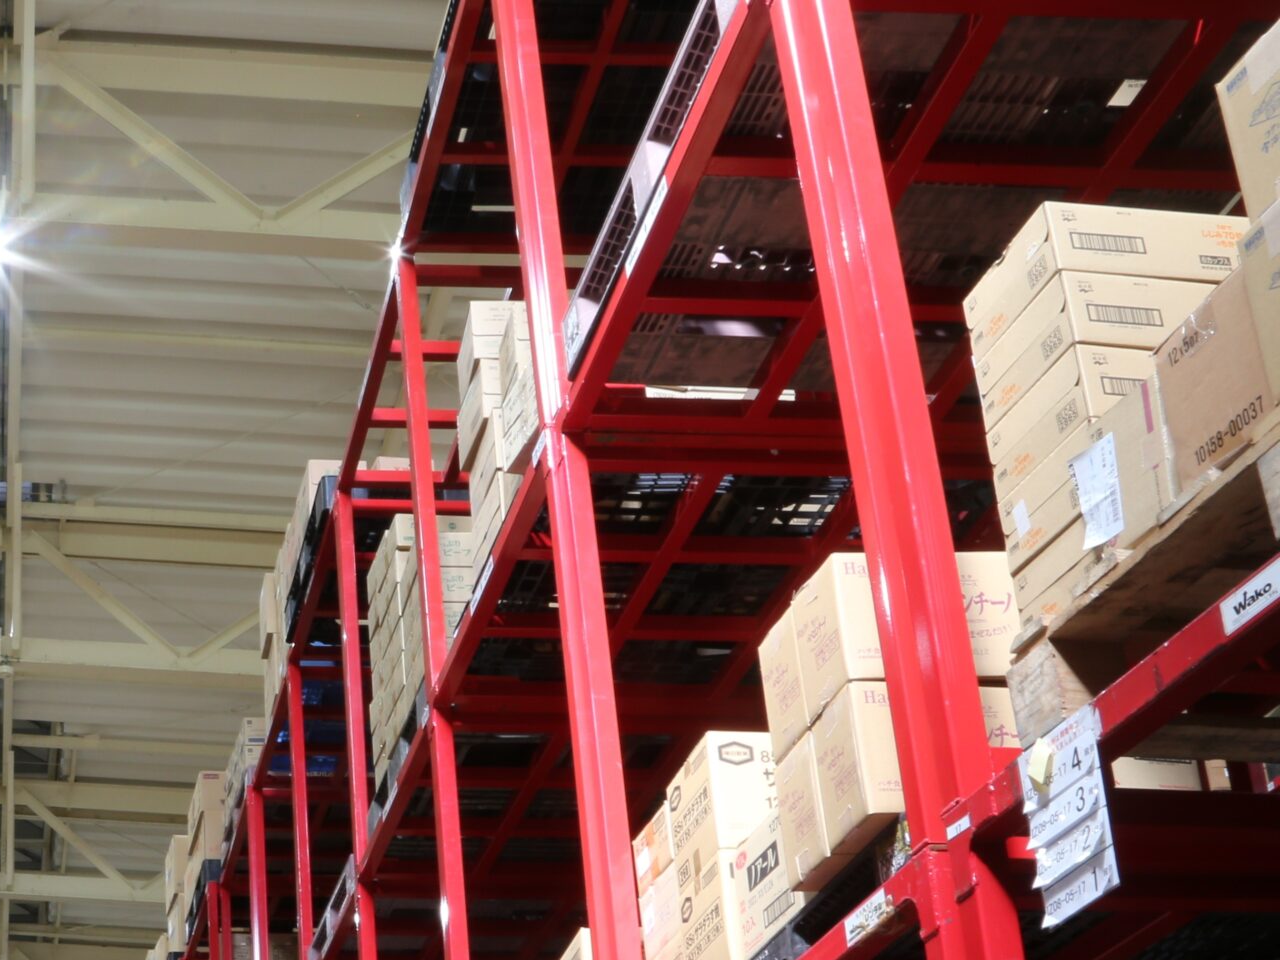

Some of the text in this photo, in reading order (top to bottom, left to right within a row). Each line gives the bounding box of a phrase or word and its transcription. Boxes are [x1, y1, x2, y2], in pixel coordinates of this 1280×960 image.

[1193, 395, 1265, 466] 10158-00037
[1233, 582, 1273, 616] Wako
[1071, 746, 1083, 772] 4
[1075, 785, 1086, 813] 3
[1082, 824, 1092, 852] 2
